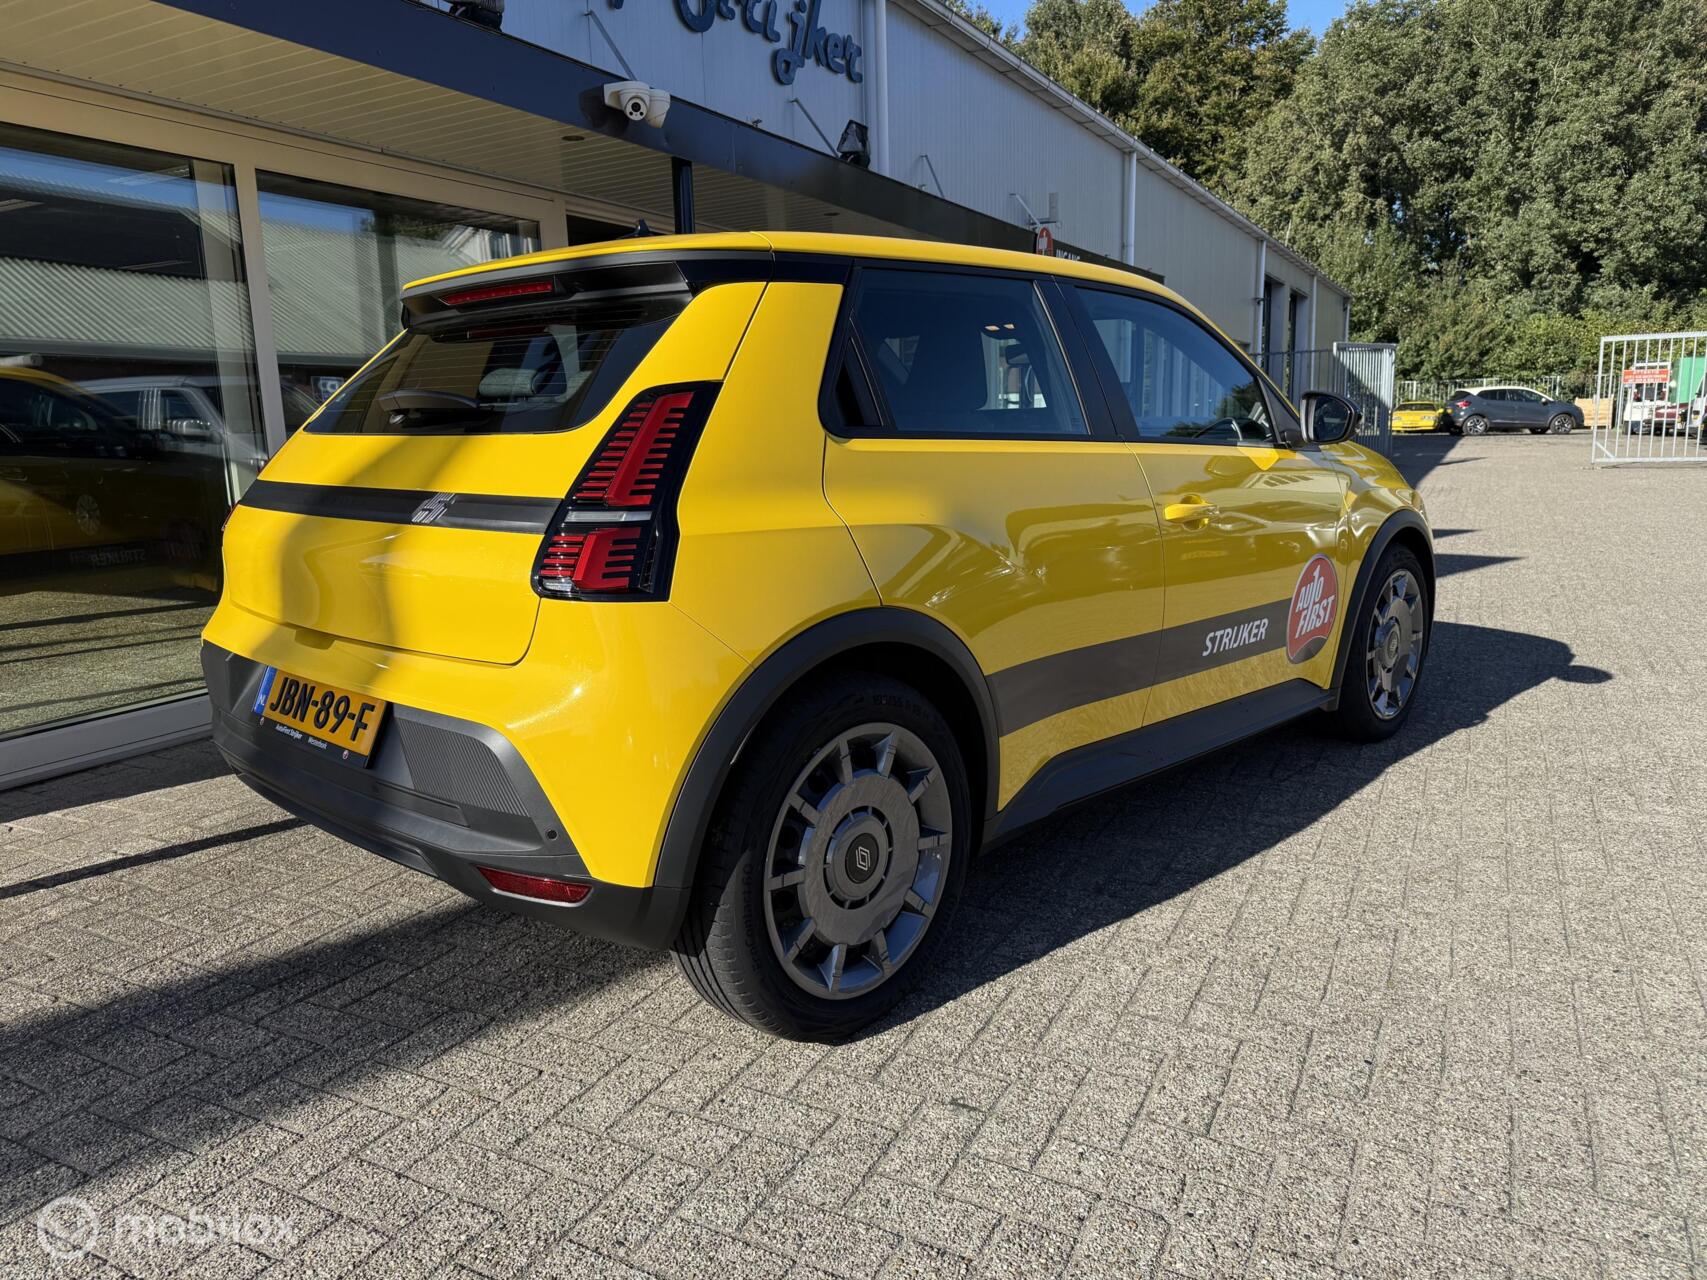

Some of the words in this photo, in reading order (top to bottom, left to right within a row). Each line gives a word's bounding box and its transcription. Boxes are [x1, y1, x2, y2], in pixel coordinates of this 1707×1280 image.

[679, 0, 863, 85] rijker
[1295, 566, 1324, 613] AUTO
[1202, 618, 1269, 657] STRIJKER
[1295, 595, 1336, 639] FIRST
[269, 676, 376, 742] JBN-89-F
